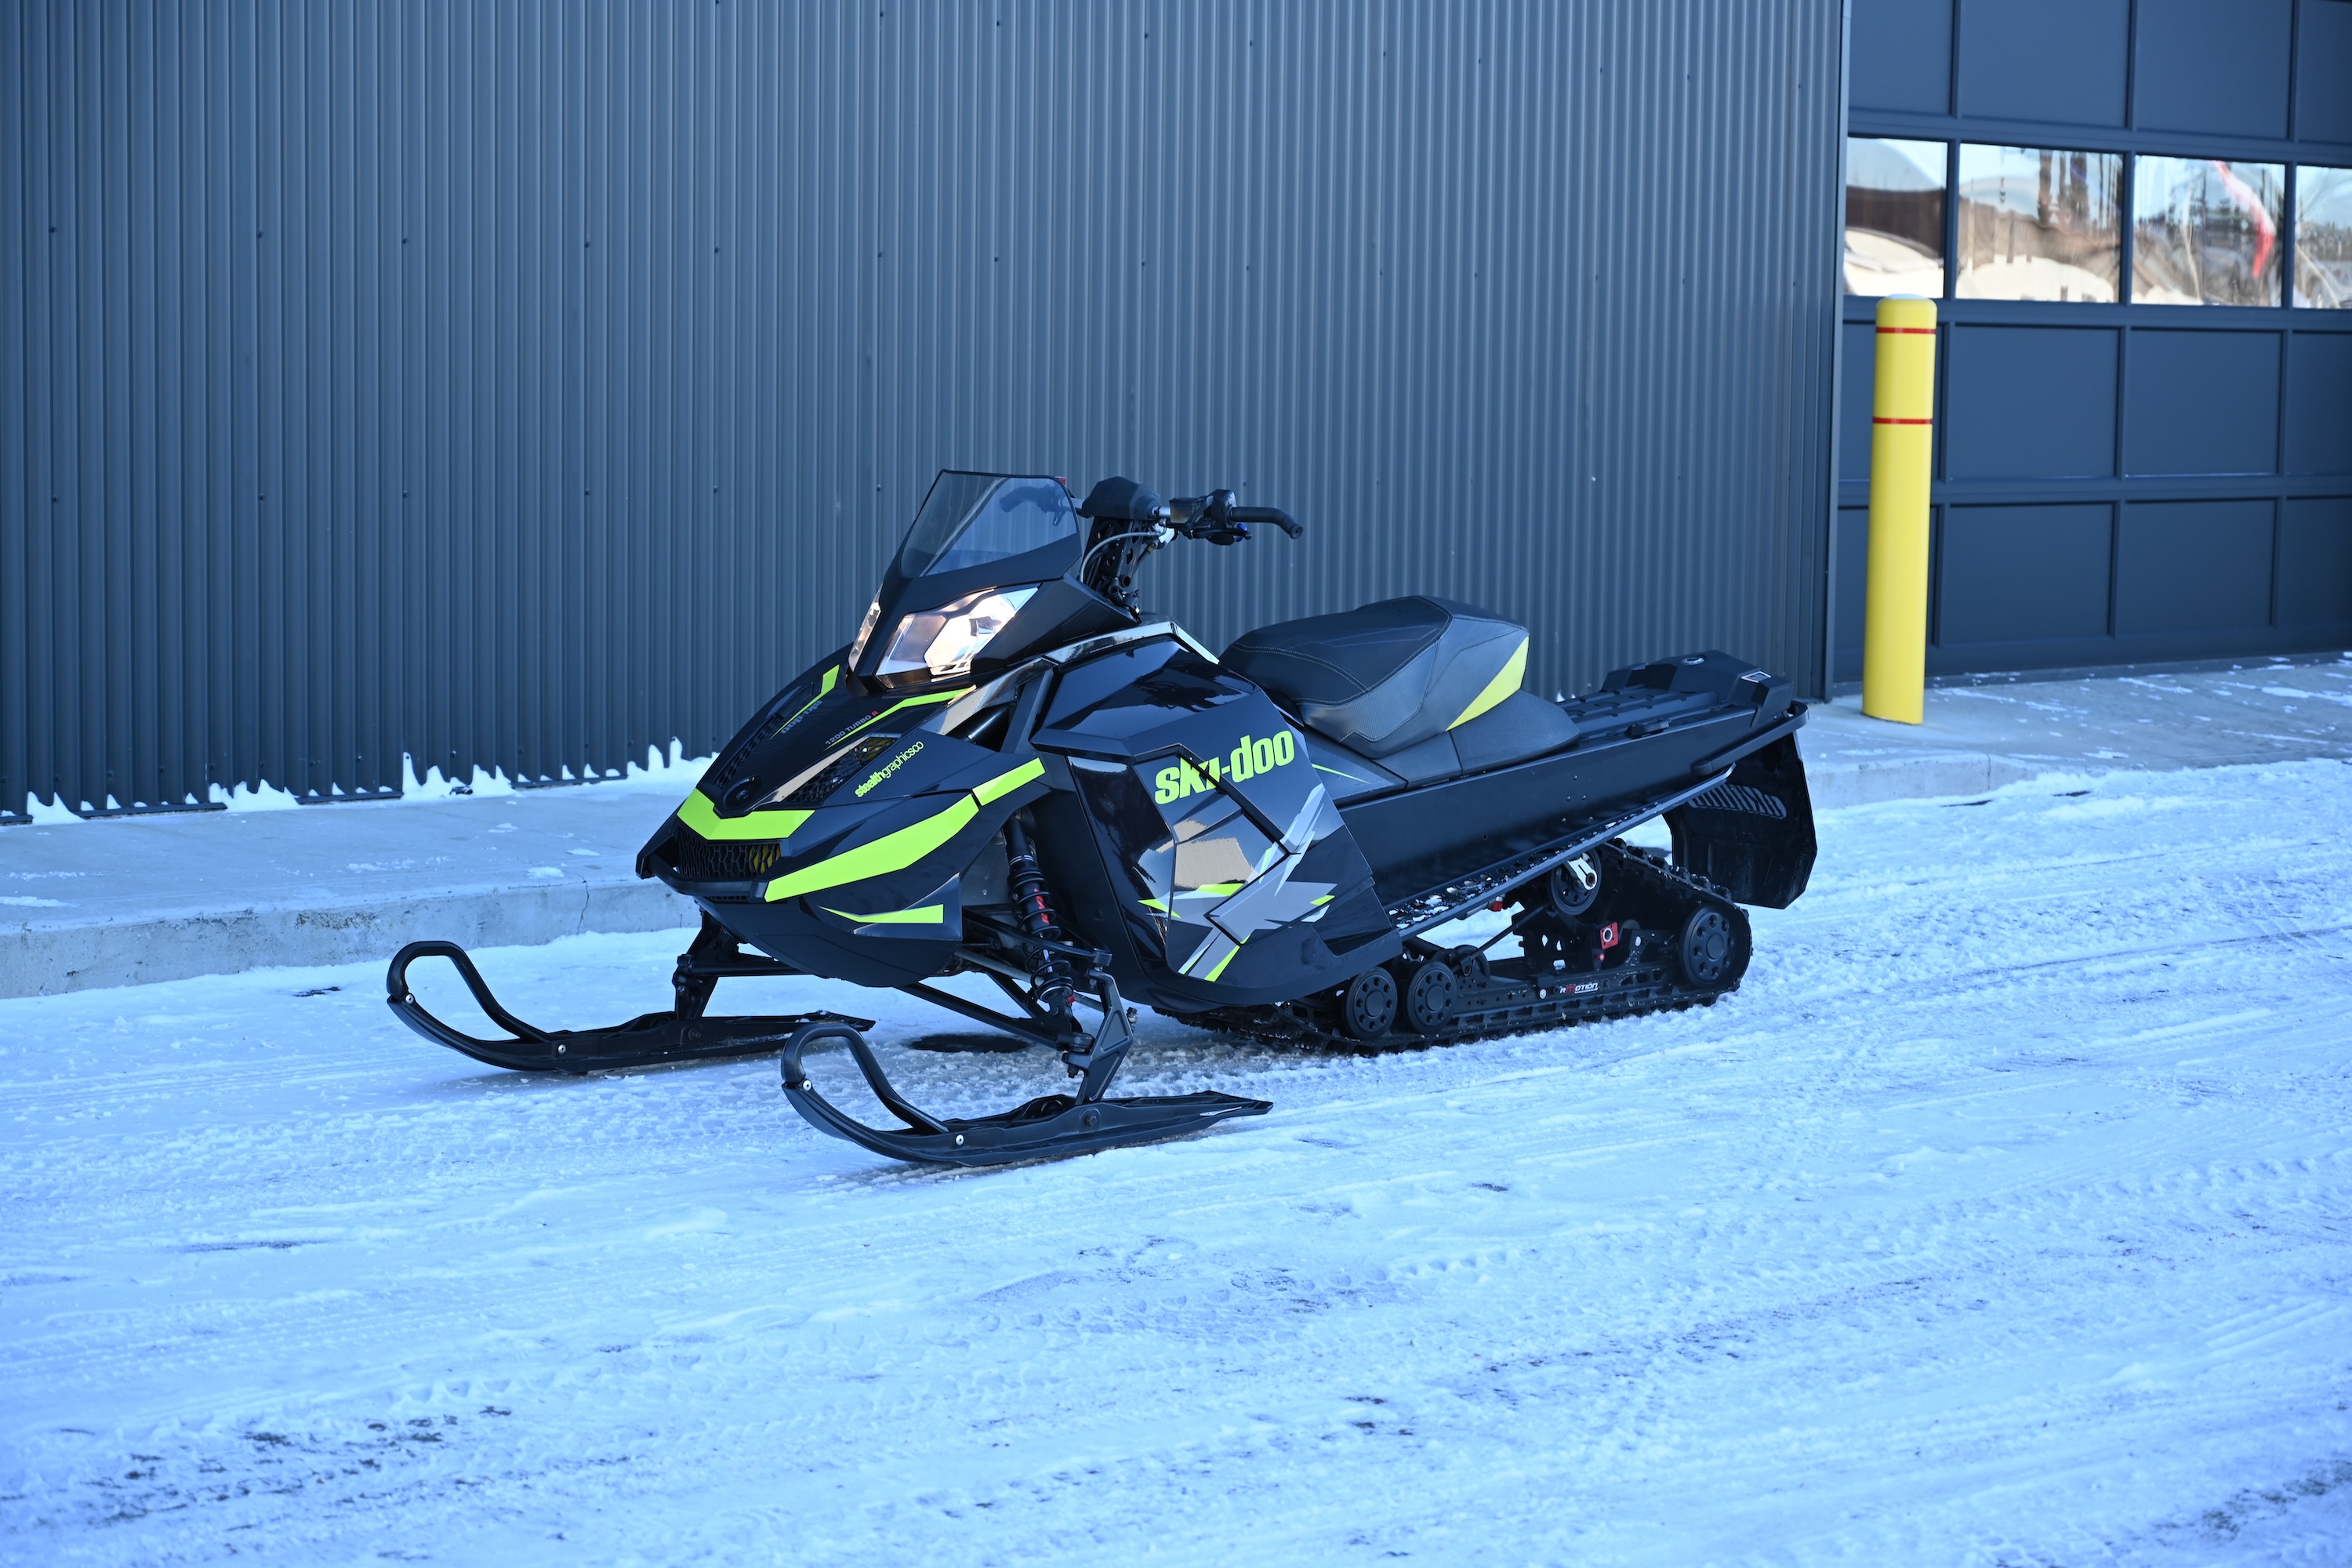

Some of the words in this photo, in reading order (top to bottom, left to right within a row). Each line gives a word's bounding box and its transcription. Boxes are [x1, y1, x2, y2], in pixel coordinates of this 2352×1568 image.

[825, 730, 847, 746] 1200
[844, 714, 872, 732] TURBO
[1155, 731, 1294, 804] ski-doo
